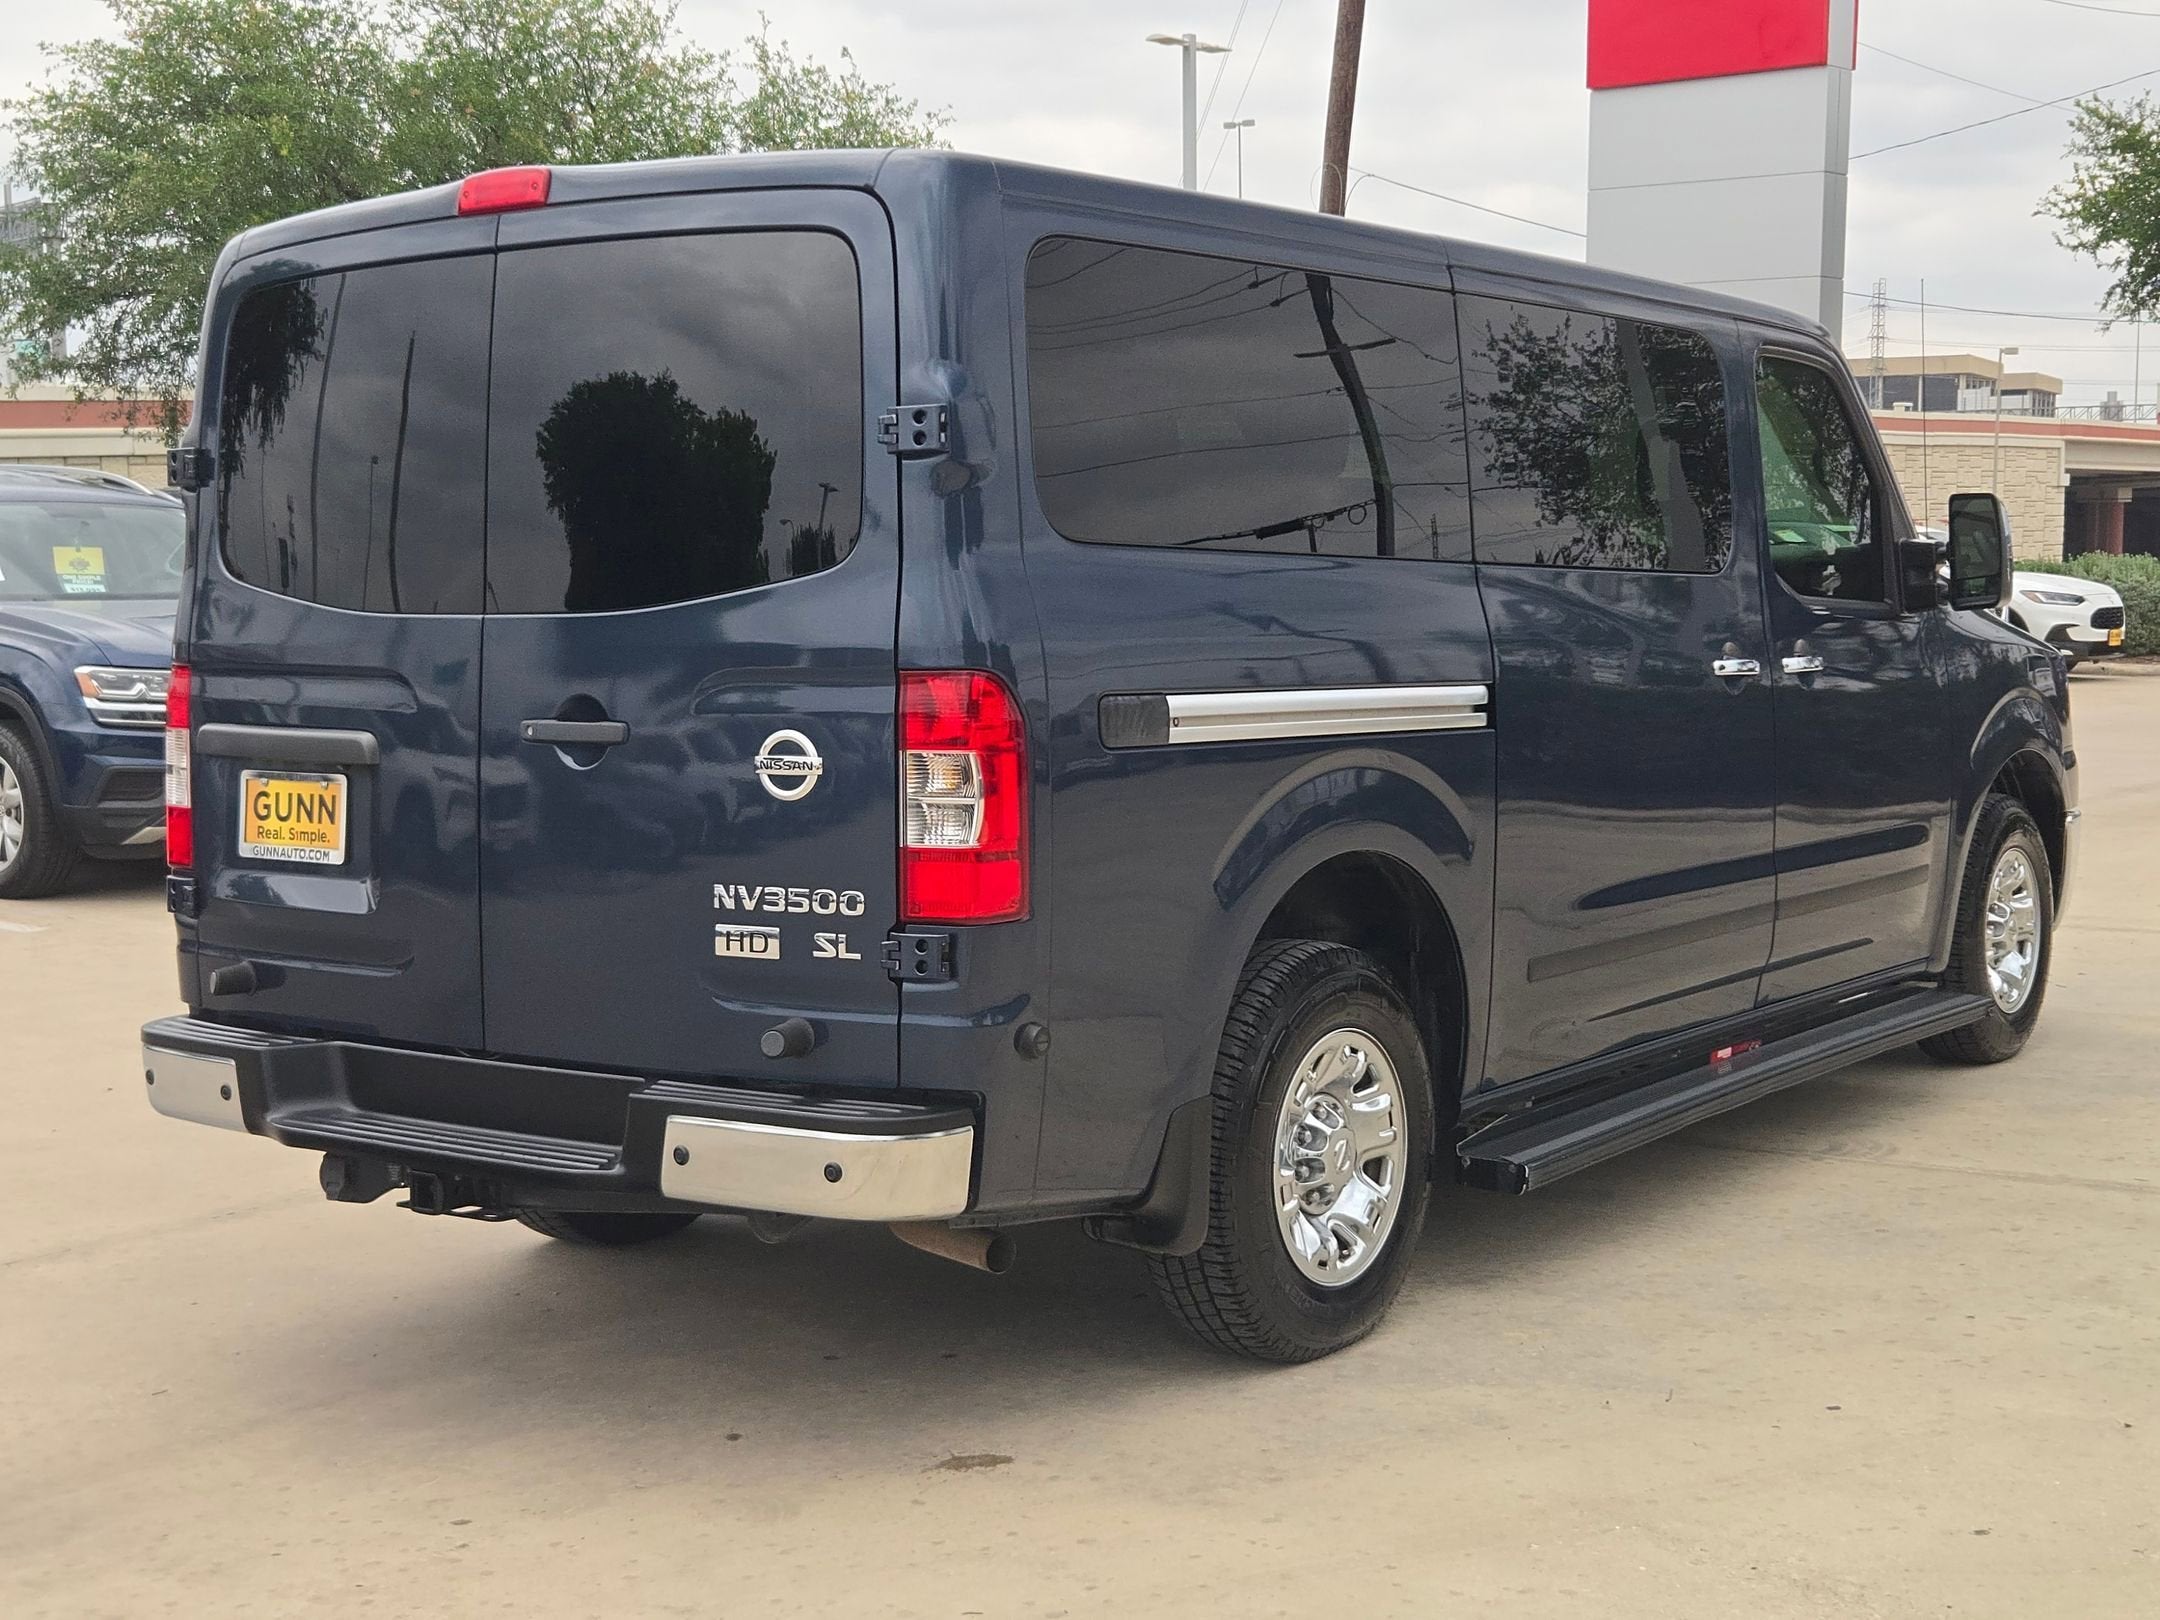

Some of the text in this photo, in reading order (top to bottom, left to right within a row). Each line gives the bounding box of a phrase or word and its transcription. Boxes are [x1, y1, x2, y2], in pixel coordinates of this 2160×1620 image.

[759, 759, 814, 771] NISSAN
[253, 790, 337, 825] GUNN
[256, 825, 331, 845] Real. Simple.
[252, 845, 330, 862] GUNNAUTO.COM
[713, 883, 866, 917] NV3500
[725, 930, 770, 954] HD
[812, 932, 862, 960] SL
